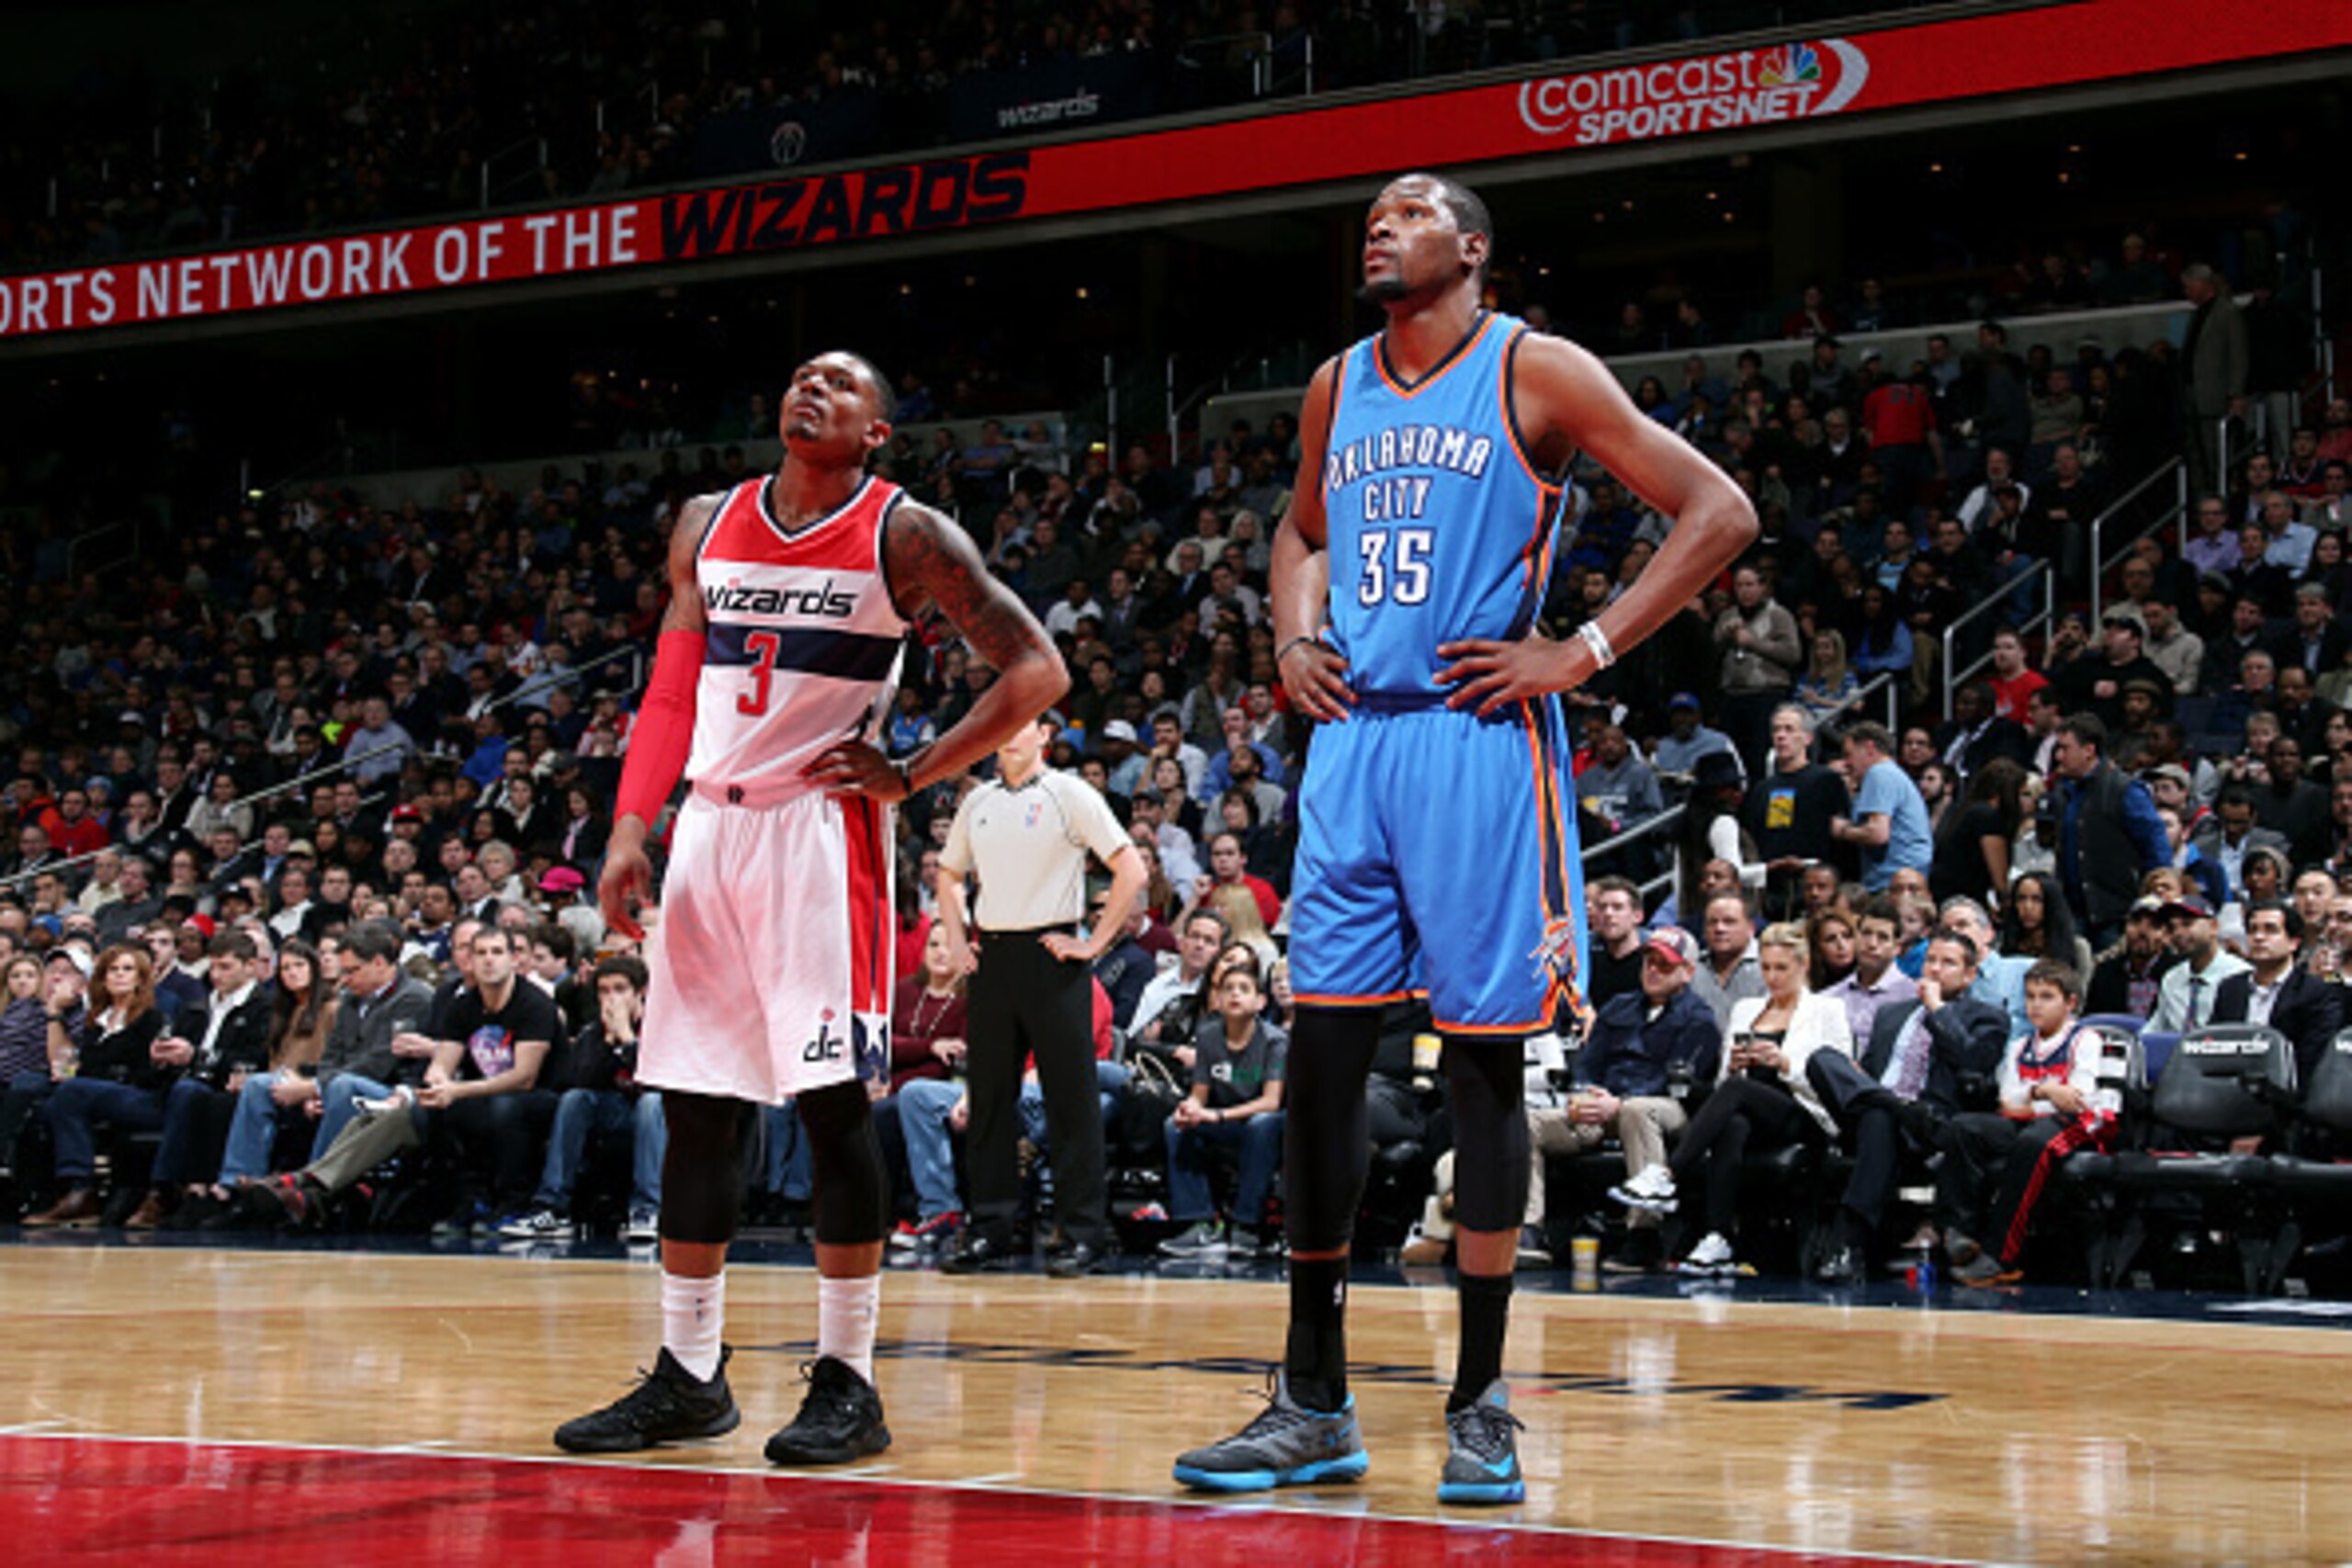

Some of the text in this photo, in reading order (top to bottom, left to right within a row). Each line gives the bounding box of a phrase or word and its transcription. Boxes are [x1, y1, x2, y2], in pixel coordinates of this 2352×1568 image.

[1576, 83, 1821, 144] SPORTSNET
[138, 233, 412, 318] NETWORK
[434, 223, 504, 283] OF
[525, 206, 638, 272] THE
[662, 152, 1031, 261] WIZARDS
[1328, 424, 1493, 492] OKLAHOMA
[1363, 477, 1433, 521] CITY
[1358, 525, 1435, 607] 35
[737, 632, 780, 717] 3
